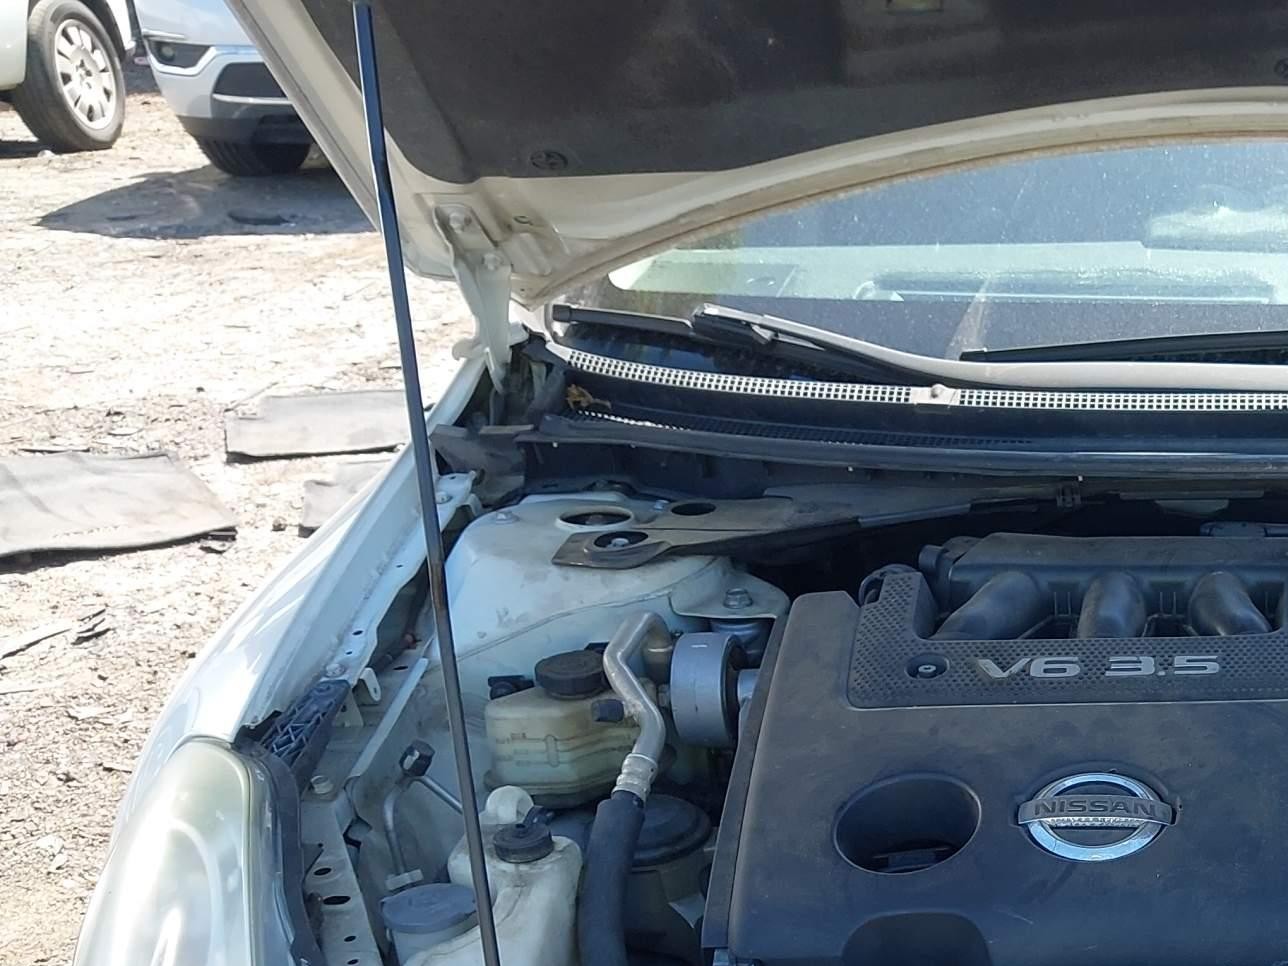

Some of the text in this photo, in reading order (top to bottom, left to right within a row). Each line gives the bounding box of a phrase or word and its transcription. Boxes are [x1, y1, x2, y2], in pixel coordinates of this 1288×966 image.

[977, 655, 1220, 678] V6 3.5
[1034, 799, 1157, 817] NISSAN
